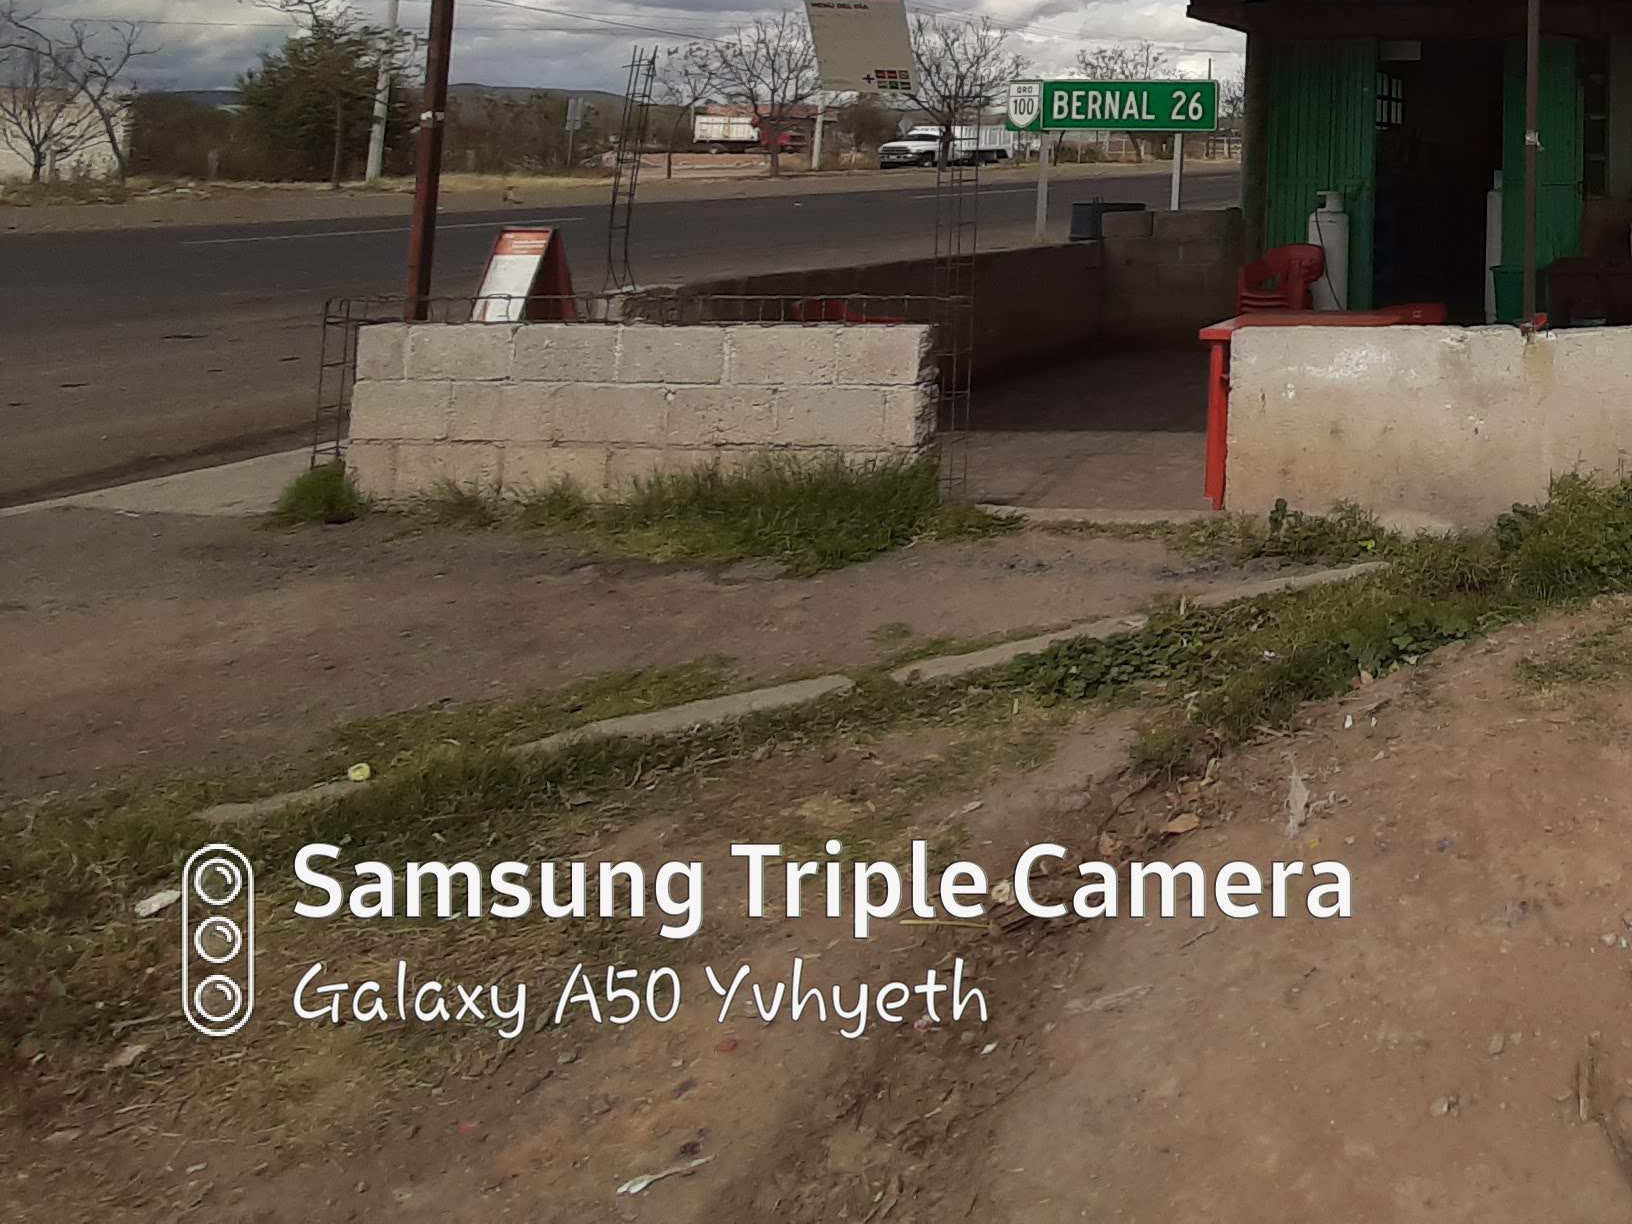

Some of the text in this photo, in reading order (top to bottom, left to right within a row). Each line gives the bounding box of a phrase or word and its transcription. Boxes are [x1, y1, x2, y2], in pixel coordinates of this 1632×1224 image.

[1016, 86, 1033, 94] QRO
[1013, 98, 1034, 115] 100
[1052, 90, 1204, 121] BERNAL 26
